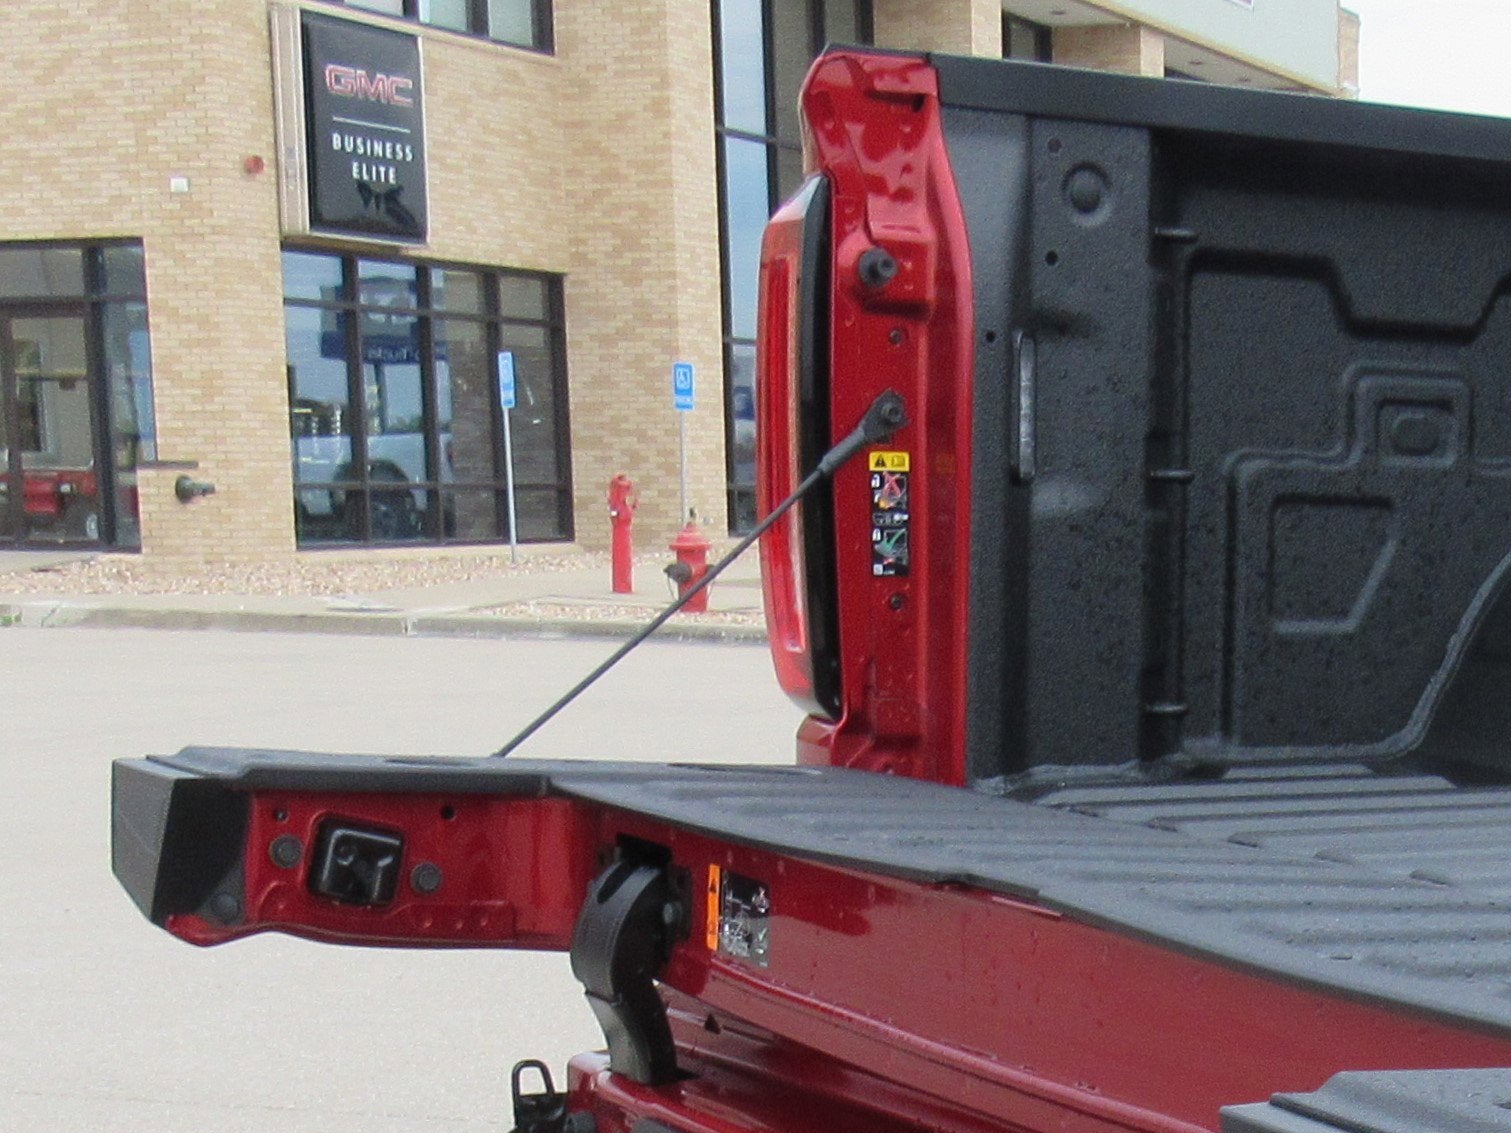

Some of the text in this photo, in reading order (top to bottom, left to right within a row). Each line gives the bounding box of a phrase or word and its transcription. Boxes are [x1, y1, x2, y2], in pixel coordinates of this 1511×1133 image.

[326, 64, 413, 107] GMC
[332, 132, 413, 162] BUSINESS
[352, 162, 397, 184] ELITE
